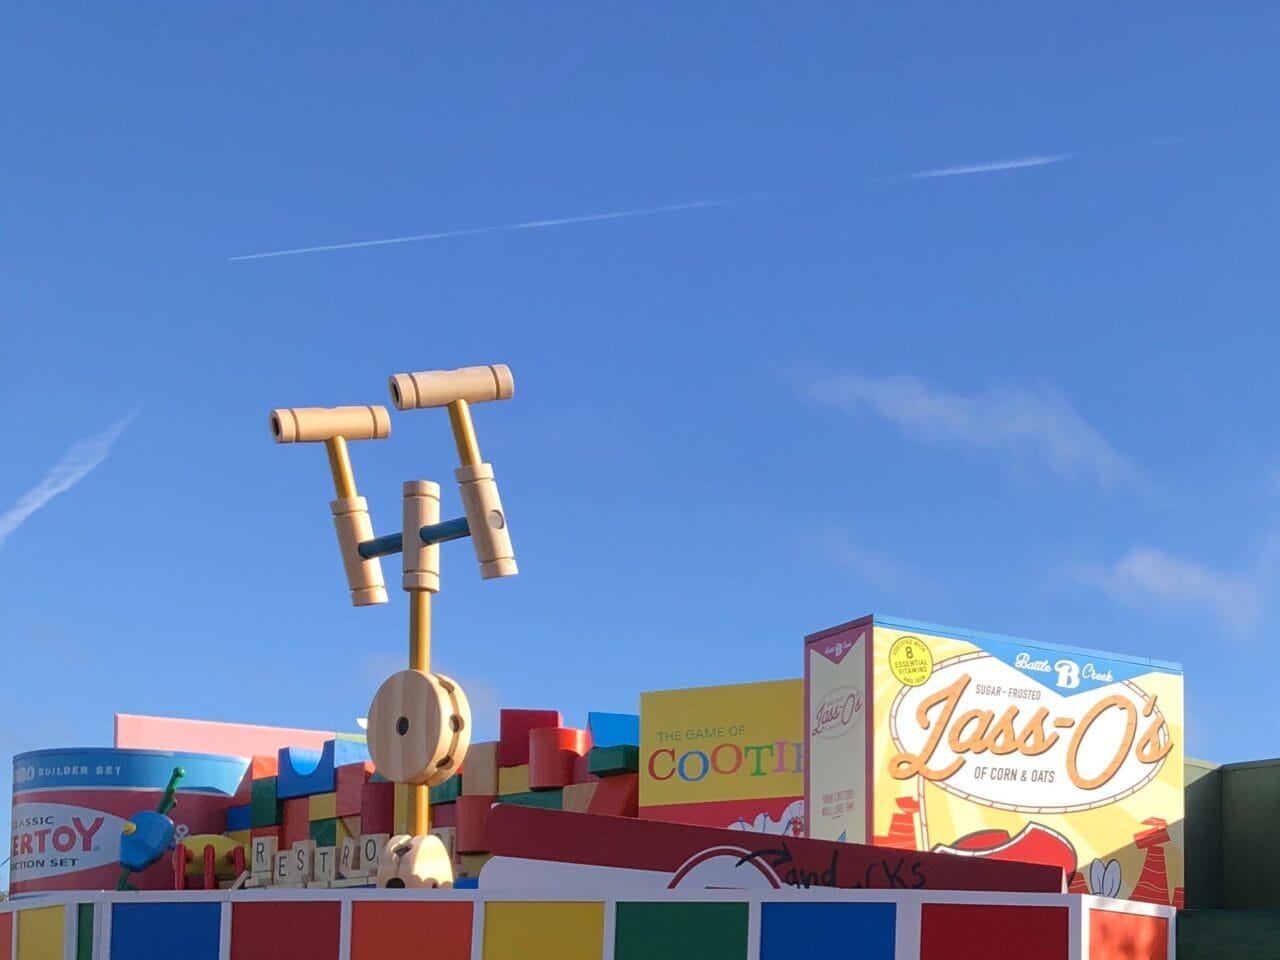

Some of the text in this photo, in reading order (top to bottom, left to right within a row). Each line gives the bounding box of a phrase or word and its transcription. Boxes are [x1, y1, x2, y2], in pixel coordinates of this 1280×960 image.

[905, 646, 914, 659] 8
[895, 659, 928, 668] ESSENTIAL
[1015, 653, 1052, 673] Battle
[1081, 663, 1115, 682] Creek
[897, 666, 928, 675] VITAMINS
[657, 730, 682, 743] THE
[686, 727, 725, 740] GAME
[95, 766, 122, 776] SET
[974, 766, 1055, 783] OF CORN & OATS
[50, 858, 79, 868] SET
